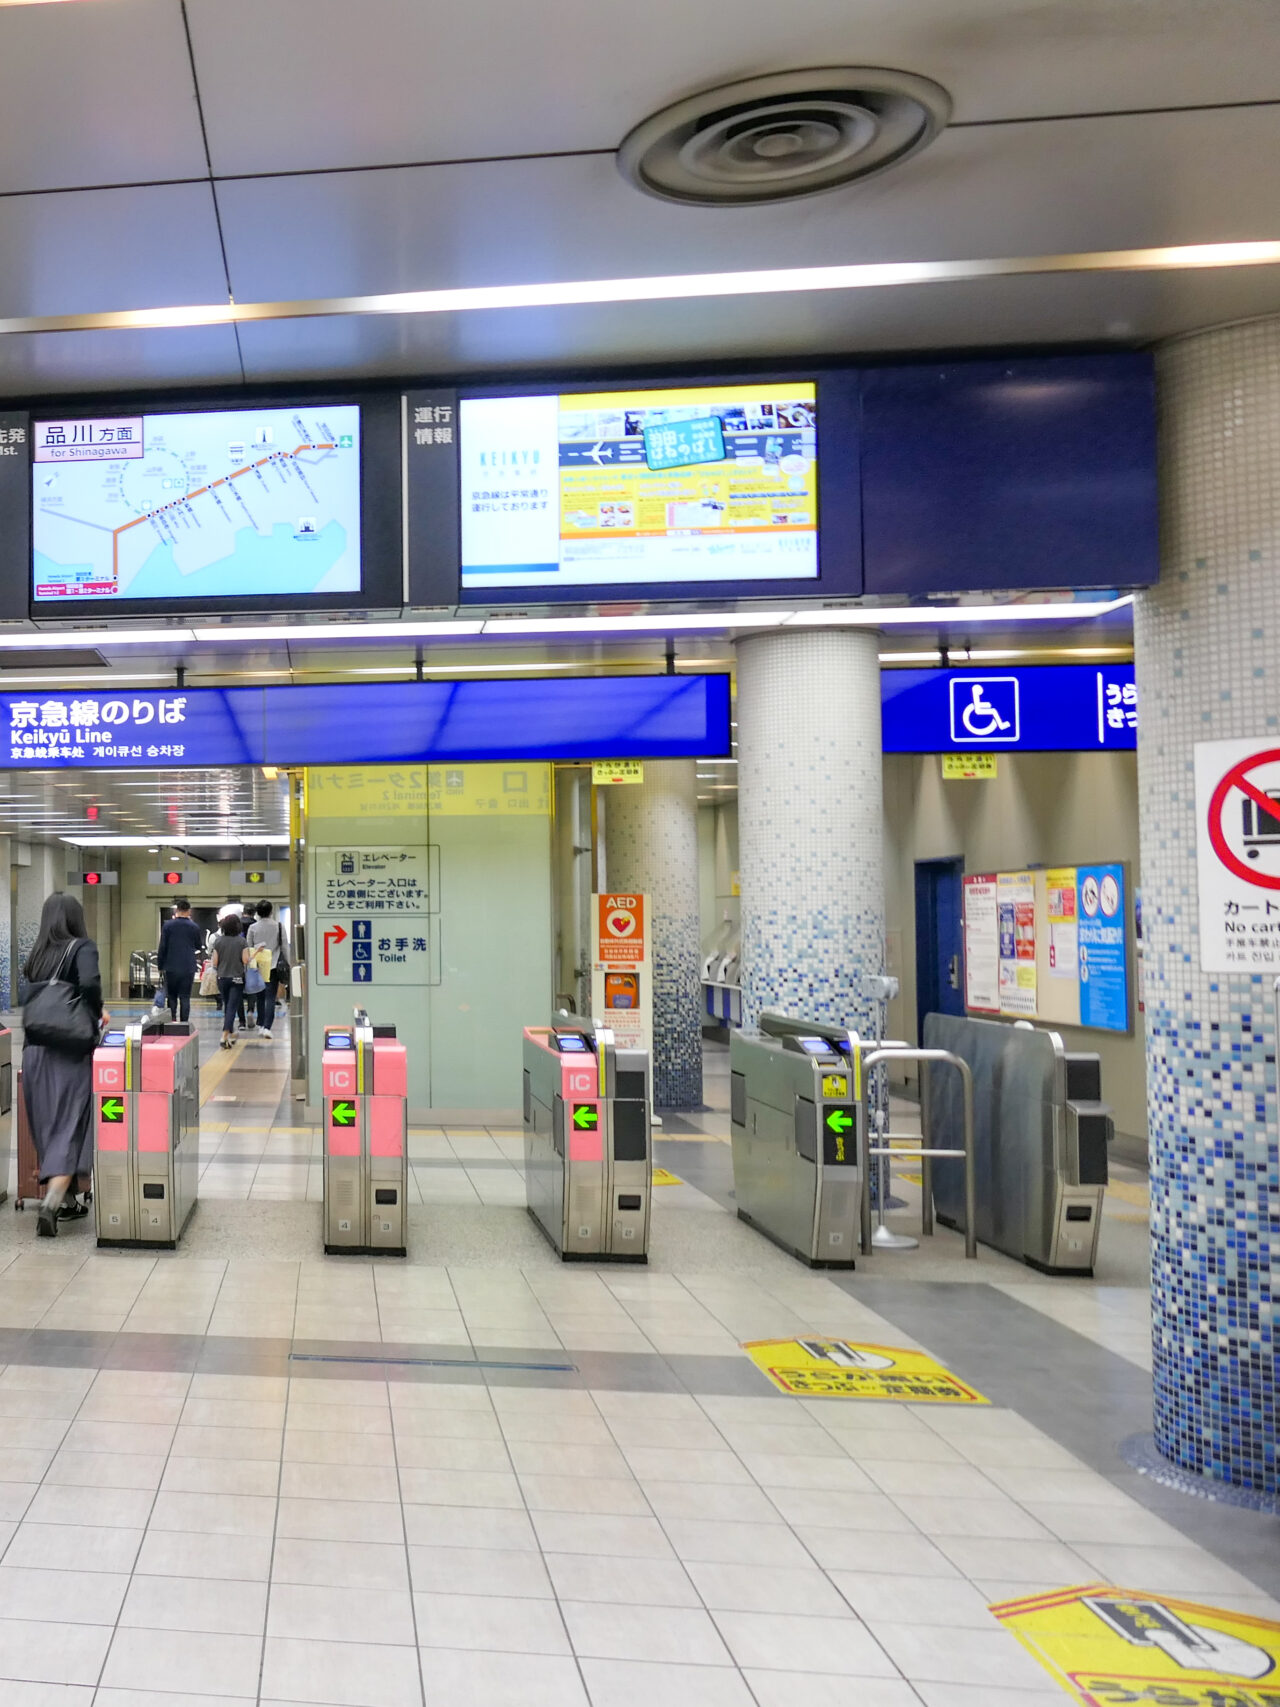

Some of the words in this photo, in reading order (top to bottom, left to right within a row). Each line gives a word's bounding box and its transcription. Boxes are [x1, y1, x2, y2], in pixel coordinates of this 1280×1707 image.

[414, 406, 453, 425] 運行
[414, 426, 454, 445] 情報
[51, 448, 67, 457] for
[69, 447, 128, 458] Shinagawa
[480, 449, 540, 466] KEIKYU
[9, 697, 187, 728] 京急線のりば
[10, 728, 70, 747] Keikyū
[75, 727, 113, 744] Line
[92, 745, 143, 757] 게이큐선
[146, 744, 186, 757] 승차장
[362, 853, 417, 862] エレベーター
[326, 878, 418, 888] エレベーター入口は
[326, 889, 429, 899] この裏側にございます。
[326, 900, 421, 910] どうぞご利用下さい。
[606, 896, 638, 909] AED
[1223, 899, 1279, 916] カート
[1224, 920, 1247, 933] No
[377, 937, 427, 952] お手洗
[378, 953, 407, 963] Toilet
[98, 1067, 119, 1084] IC
[328, 1071, 350, 1088] IC
[569, 1074, 591, 1091] IC
